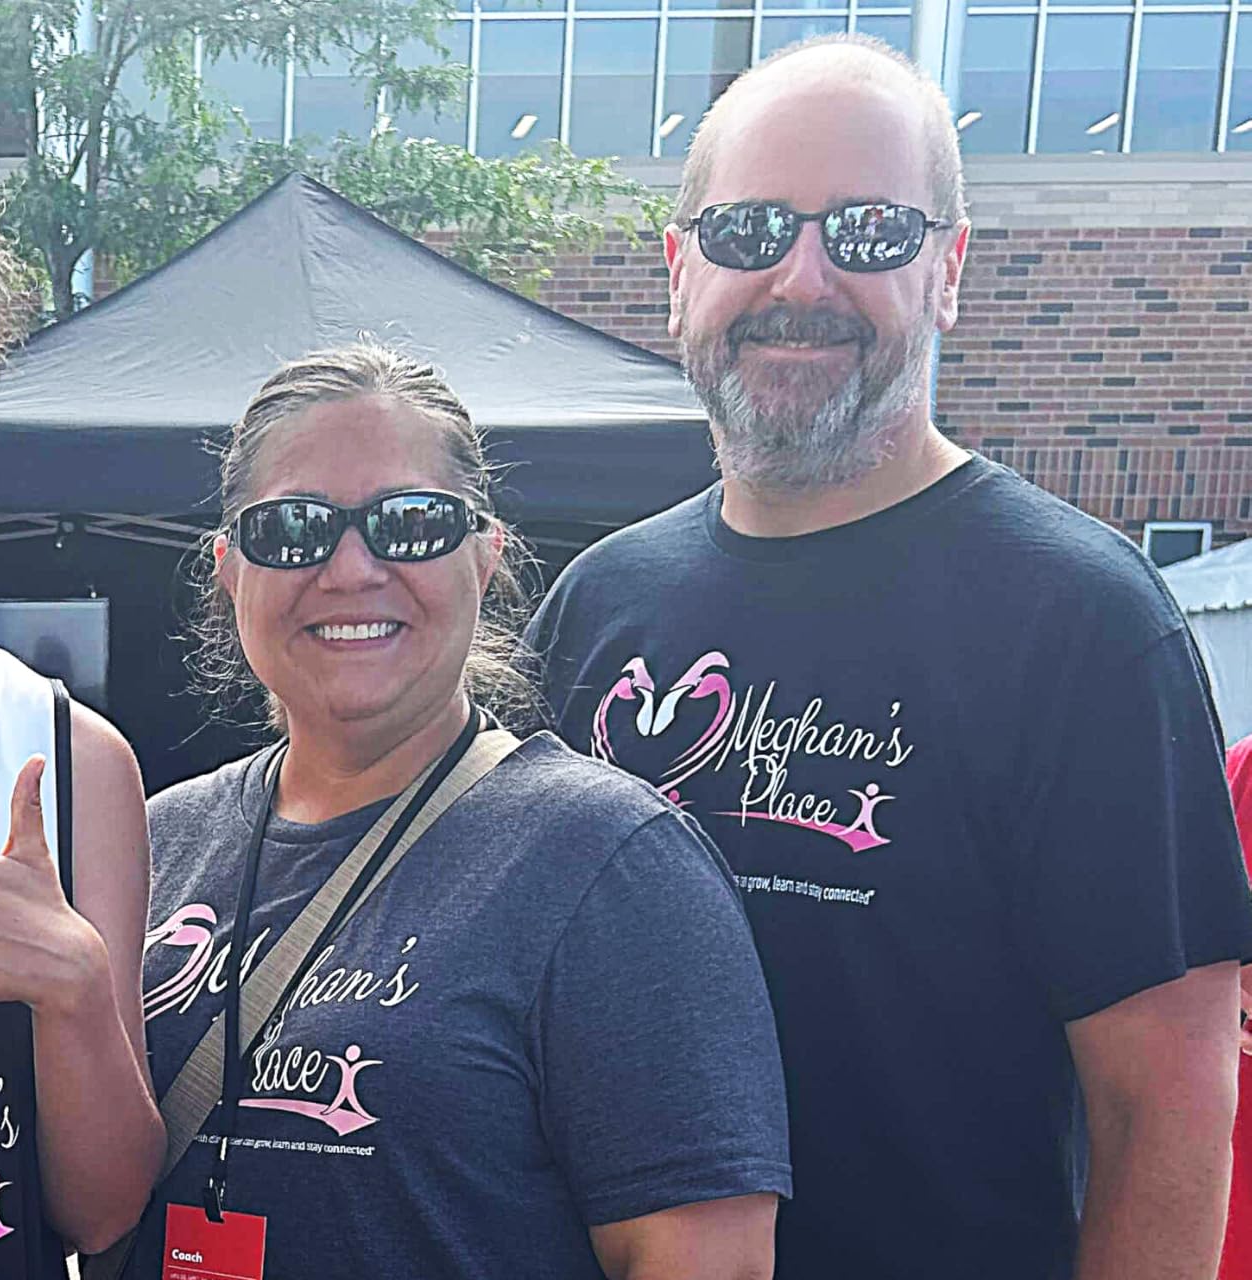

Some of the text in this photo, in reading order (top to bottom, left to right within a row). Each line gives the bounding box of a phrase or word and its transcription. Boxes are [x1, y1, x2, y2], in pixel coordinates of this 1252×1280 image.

[715, 681, 914, 772] Meghan's
[740, 753, 837, 827] Place
[773, 875, 794, 892] learn
[179, 928, 419, 1014] Mhan's
[171, 1249, 203, 1263] Coach
